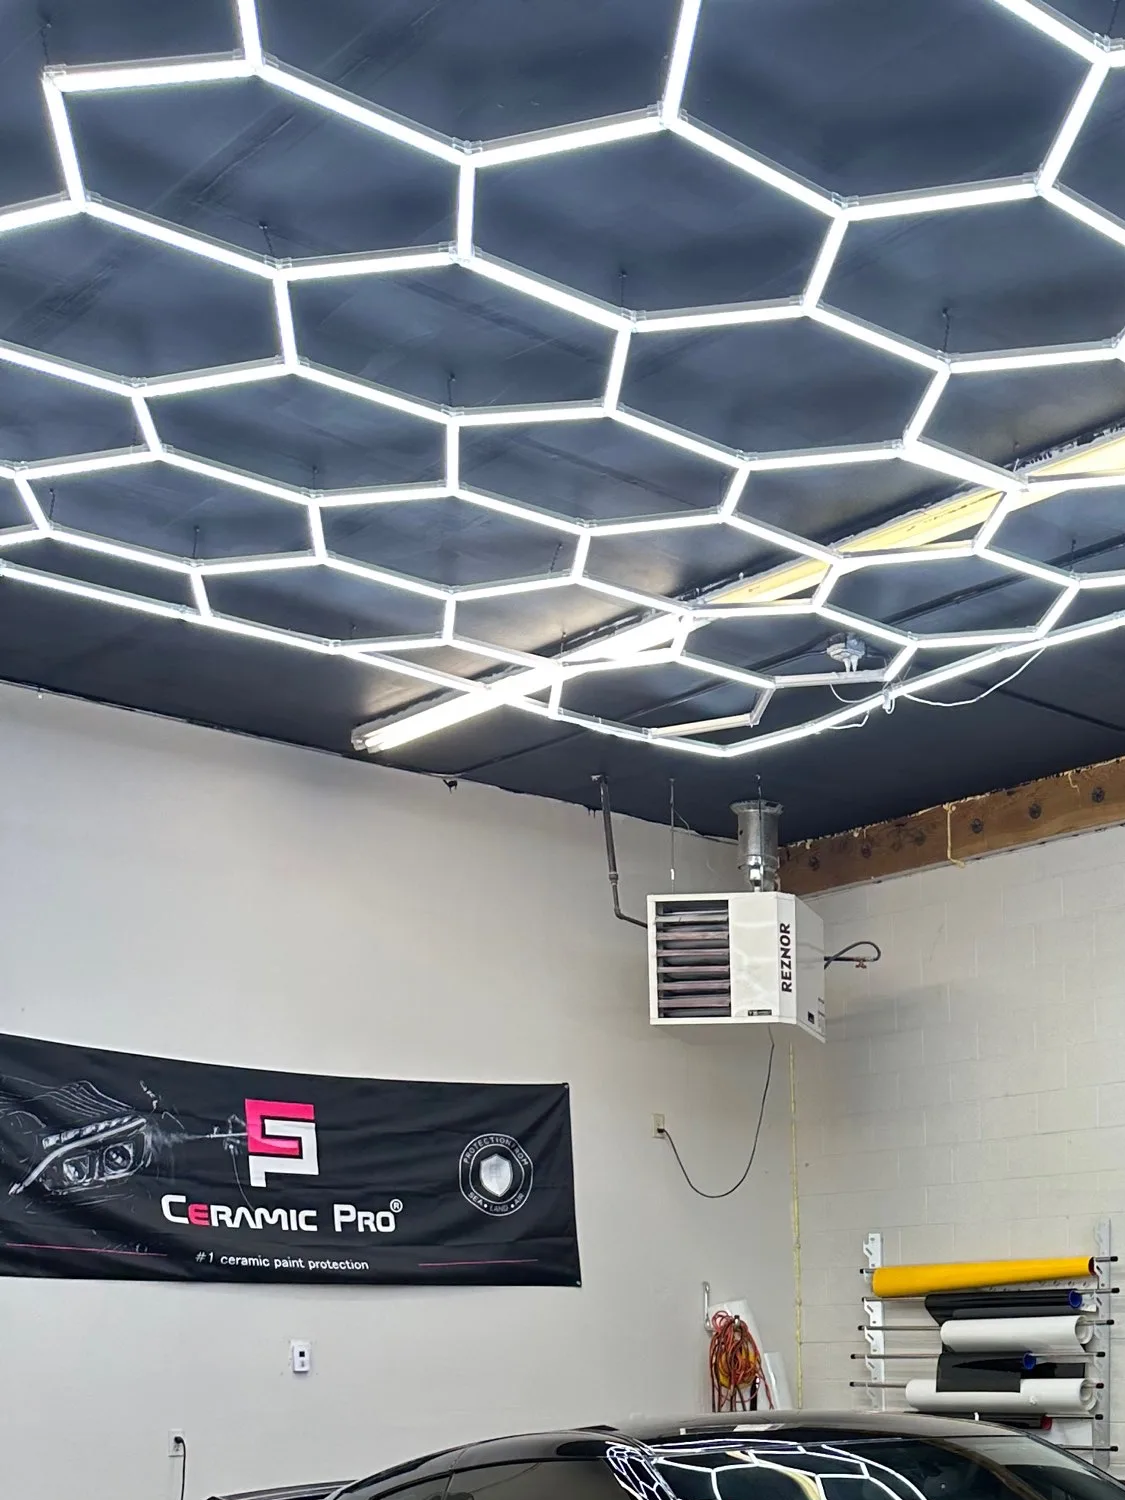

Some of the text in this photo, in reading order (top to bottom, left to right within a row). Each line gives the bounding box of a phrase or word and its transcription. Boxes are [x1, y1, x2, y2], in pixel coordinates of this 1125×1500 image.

[779, 922, 793, 993] REZNOR
[463, 1137, 511, 1164] PROTECTION
[468, 1191, 484, 1206] SEA
[195, 1251, 370, 1271] #1 ceramic paint protection
